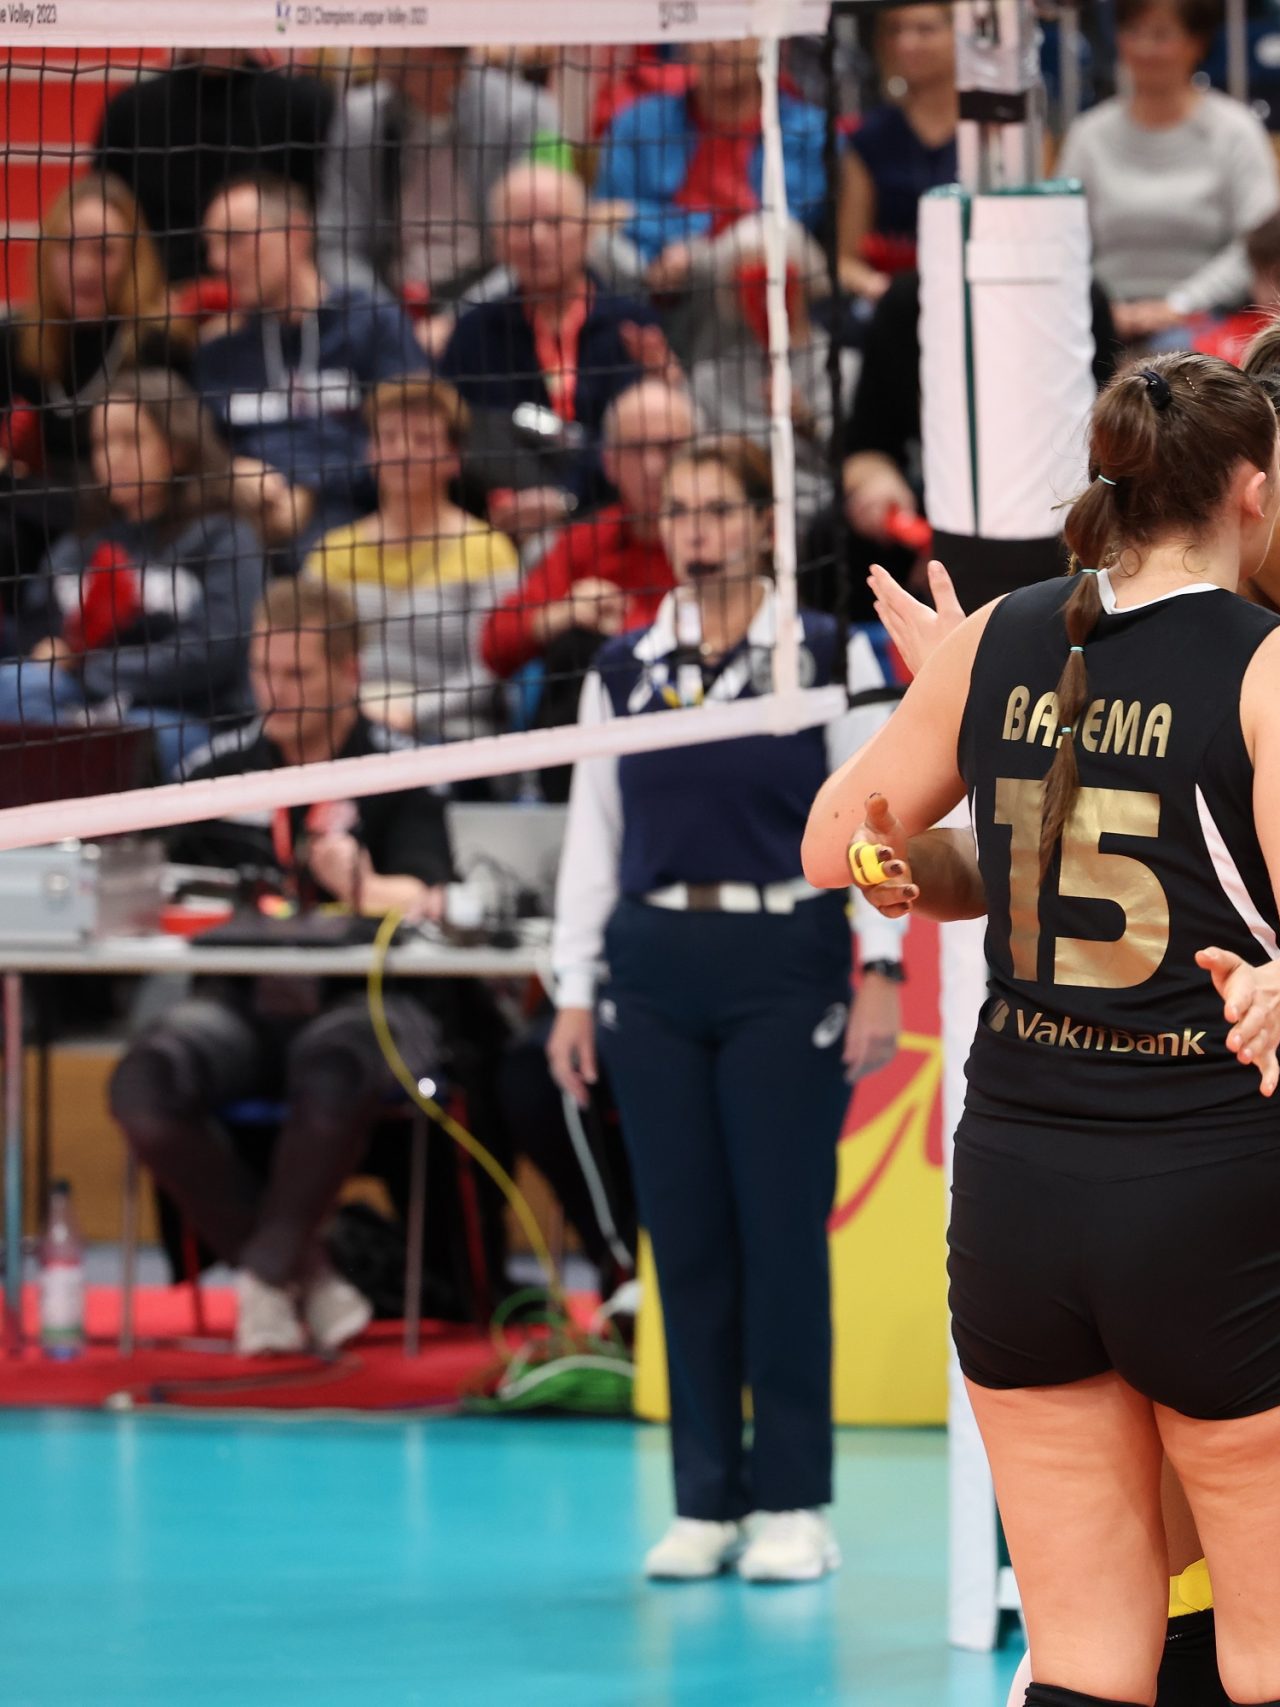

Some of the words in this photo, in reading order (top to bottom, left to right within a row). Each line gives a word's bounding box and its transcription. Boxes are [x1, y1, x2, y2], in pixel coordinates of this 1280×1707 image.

[8, 3, 34, 29] Volley
[37, 4, 57, 23] 2023
[994, 777, 1169, 989] 15
